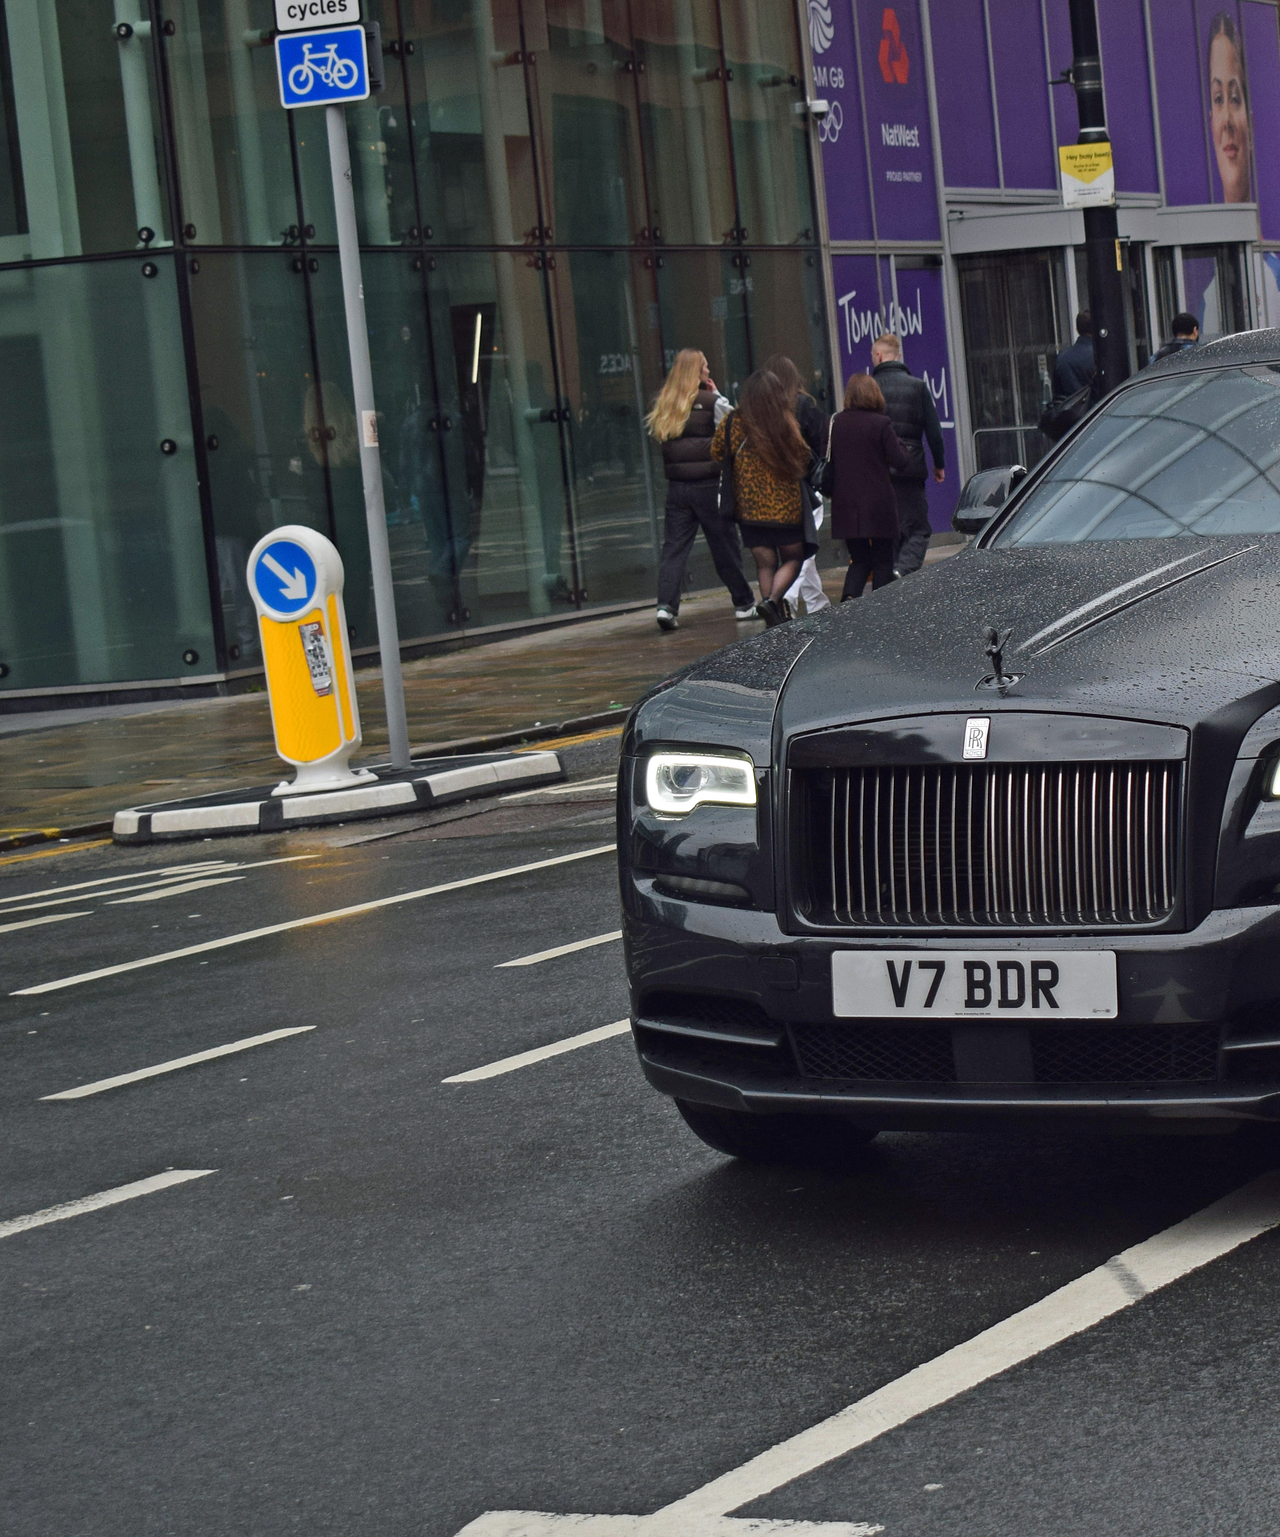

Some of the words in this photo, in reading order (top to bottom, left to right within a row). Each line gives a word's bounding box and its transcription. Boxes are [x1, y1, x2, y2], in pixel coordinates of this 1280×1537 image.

[287, 0, 347, 20] cycles
[830, 67, 844, 88] GB
[881, 123, 920, 147] NatWest
[886, 960, 945, 1007] V7
[963, 960, 1060, 1008] BDR
